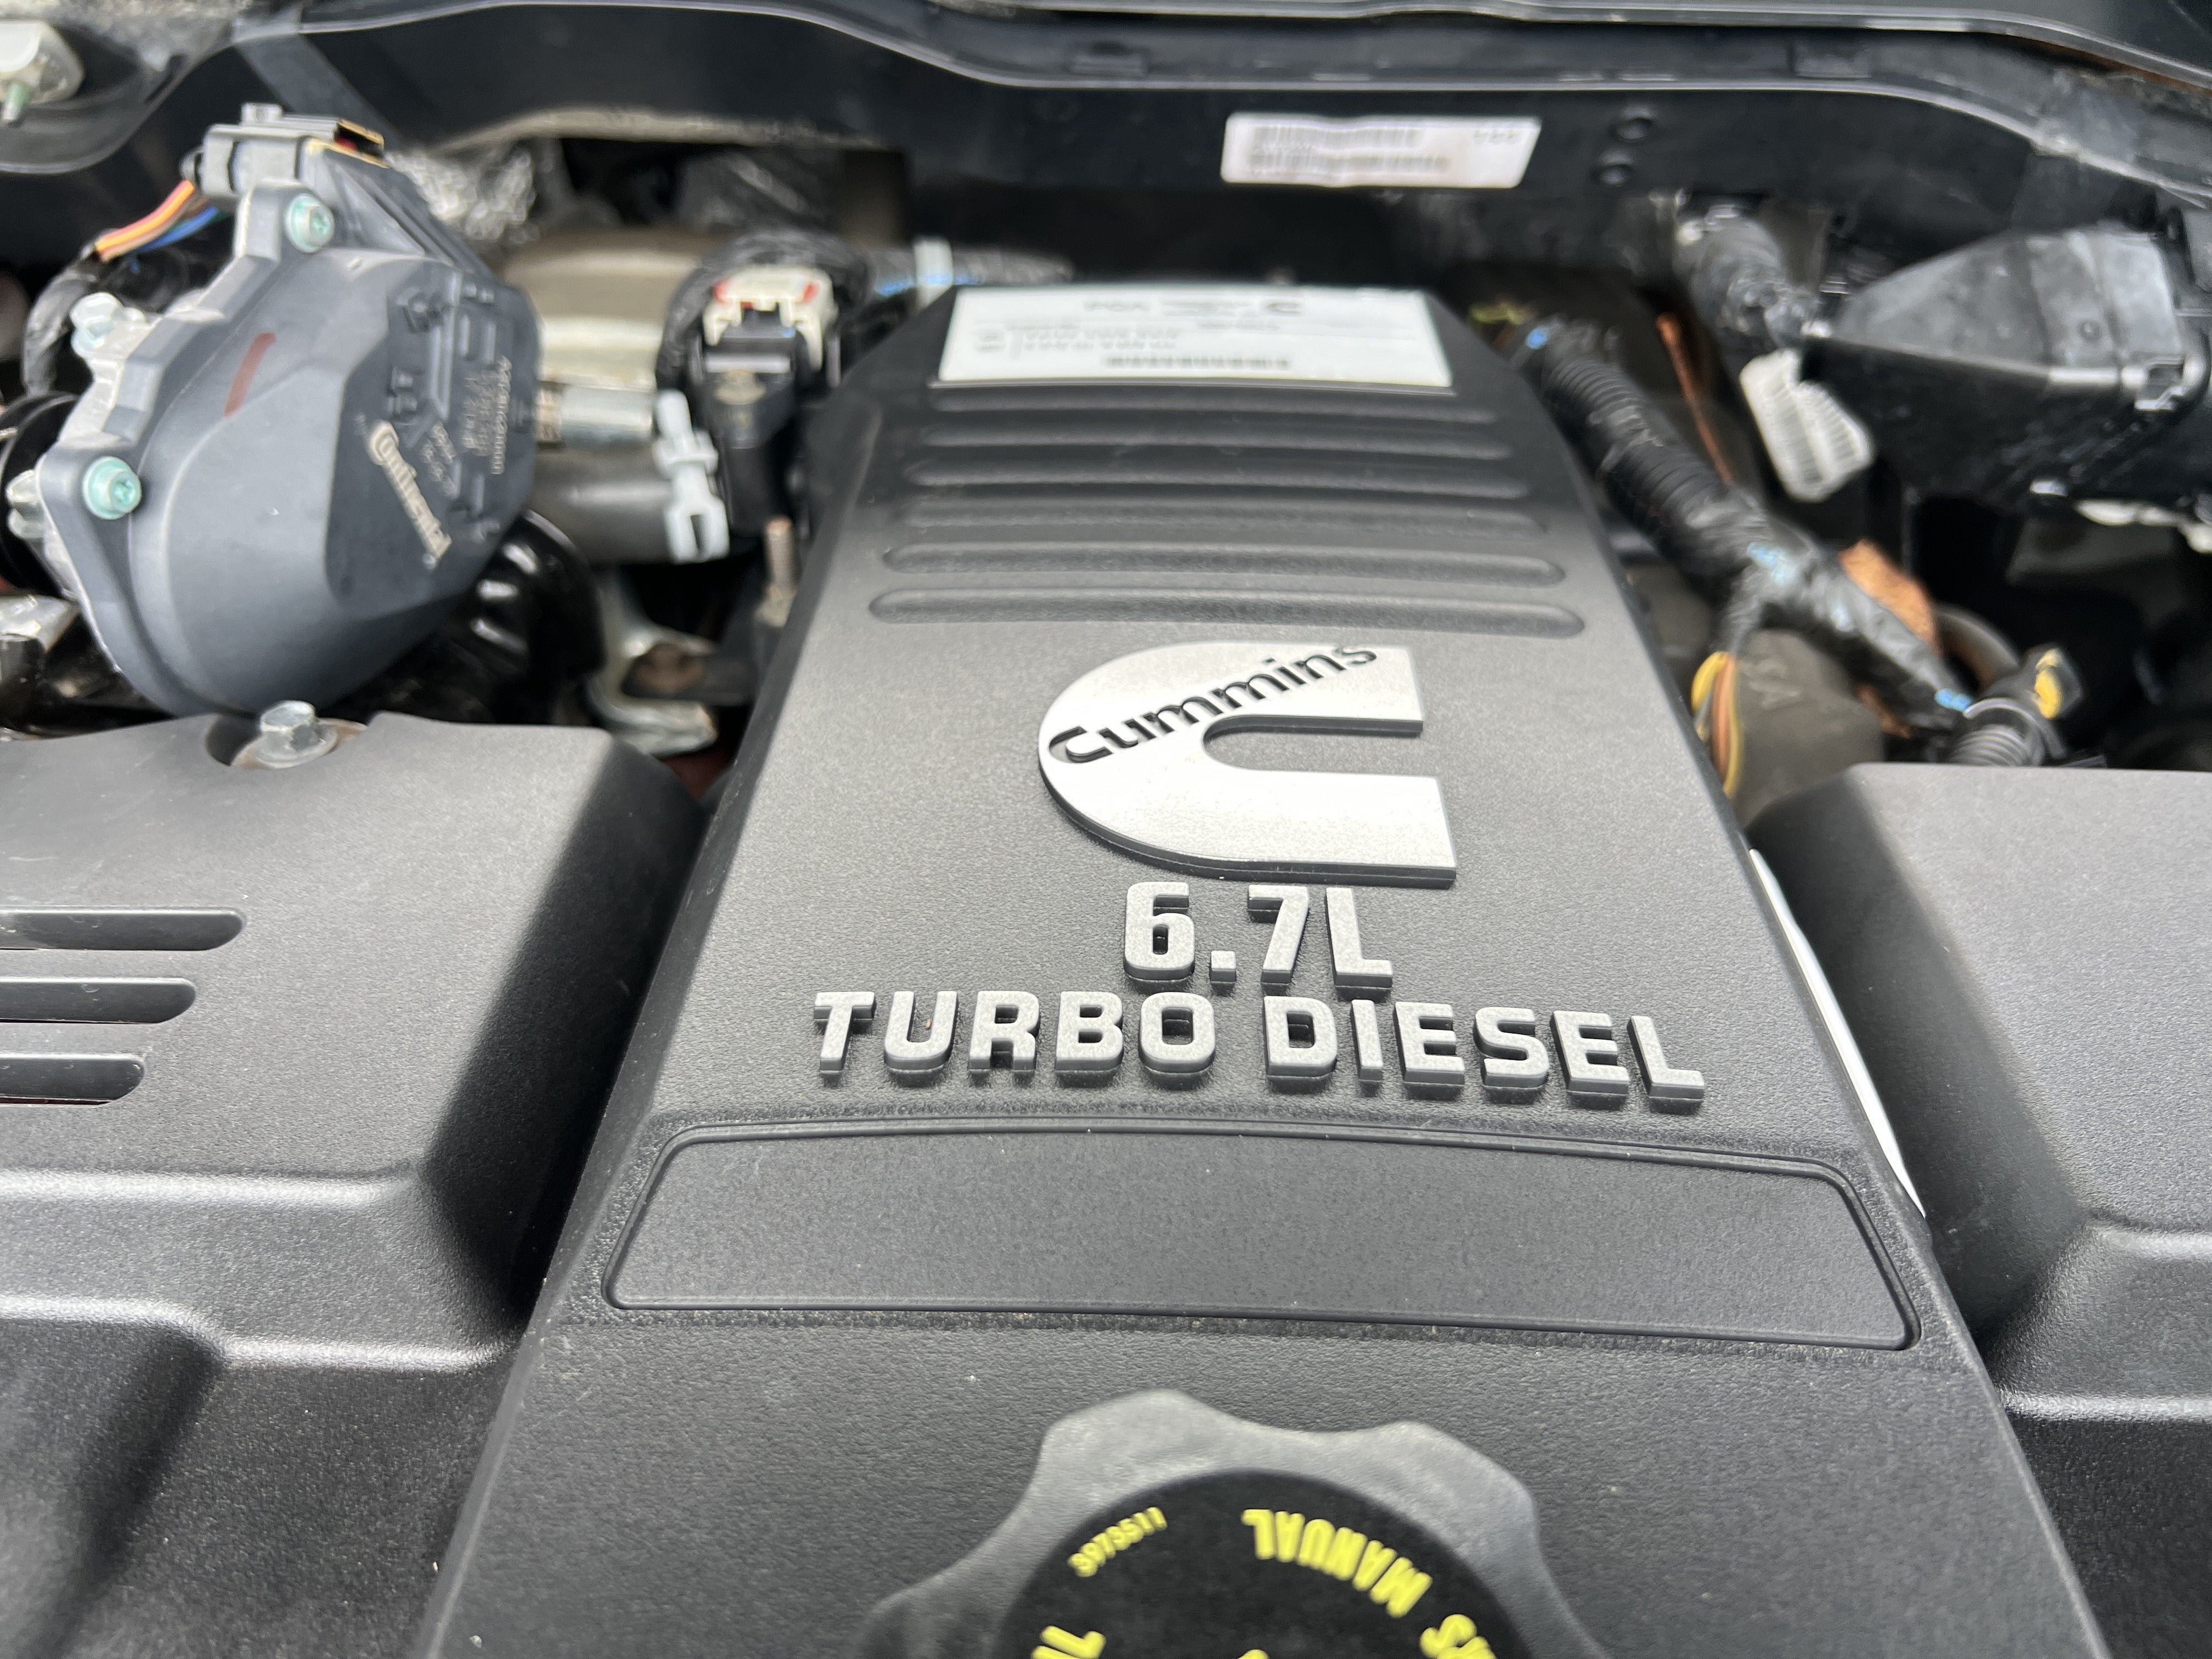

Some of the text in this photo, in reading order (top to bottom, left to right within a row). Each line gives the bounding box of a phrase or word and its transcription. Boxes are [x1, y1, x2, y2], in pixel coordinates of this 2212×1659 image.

[1047, 644, 1378, 764] Cummins
[1122, 881, 1394, 989] 6.7L
[813, 990, 1705, 1101] TURBO DIESEL
[1241, 1508, 1432, 1618] MANUAL
